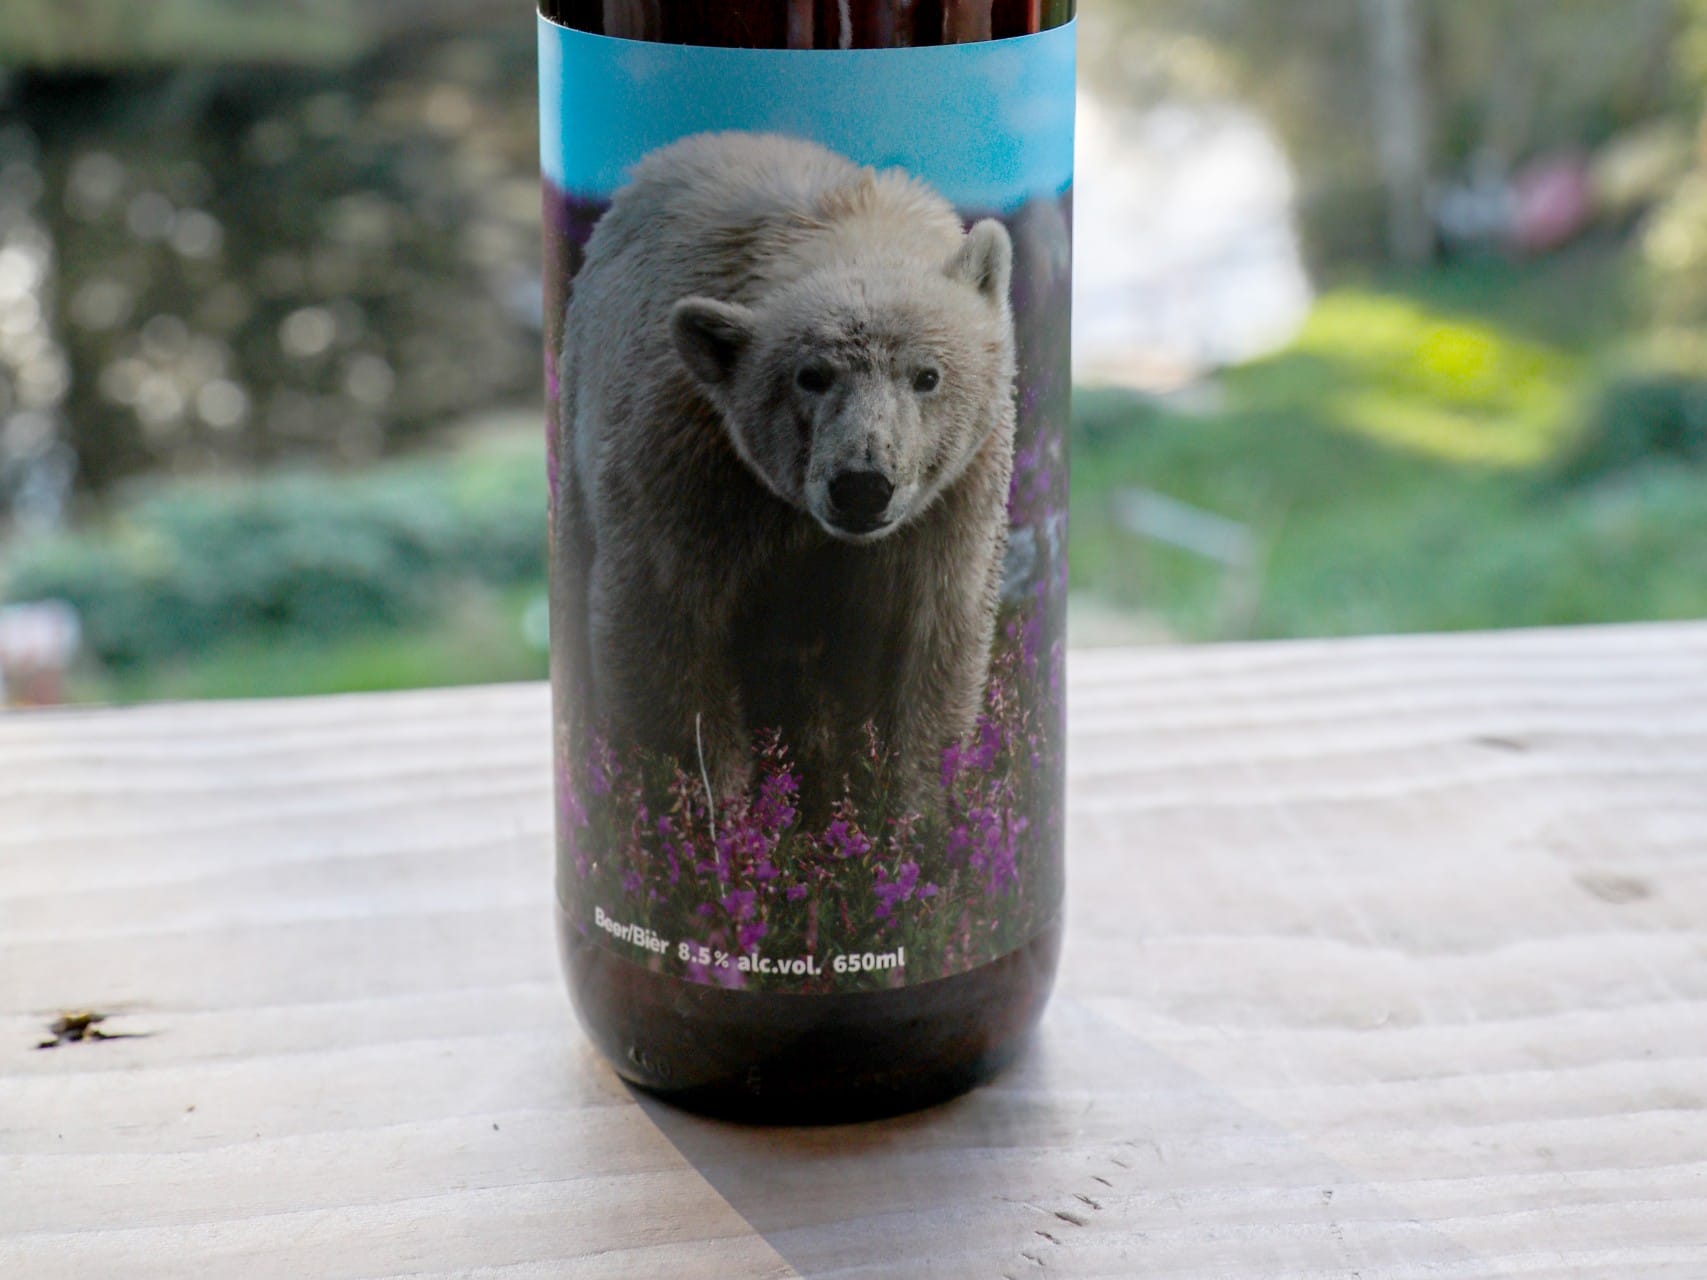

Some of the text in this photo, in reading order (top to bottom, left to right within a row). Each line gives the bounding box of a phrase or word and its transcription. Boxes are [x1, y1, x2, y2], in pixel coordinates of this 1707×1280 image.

[677, 941, 729, 968] 8.5%
[737, 952, 822, 975] alc.vol.
[832, 946, 905, 973] 650ml
